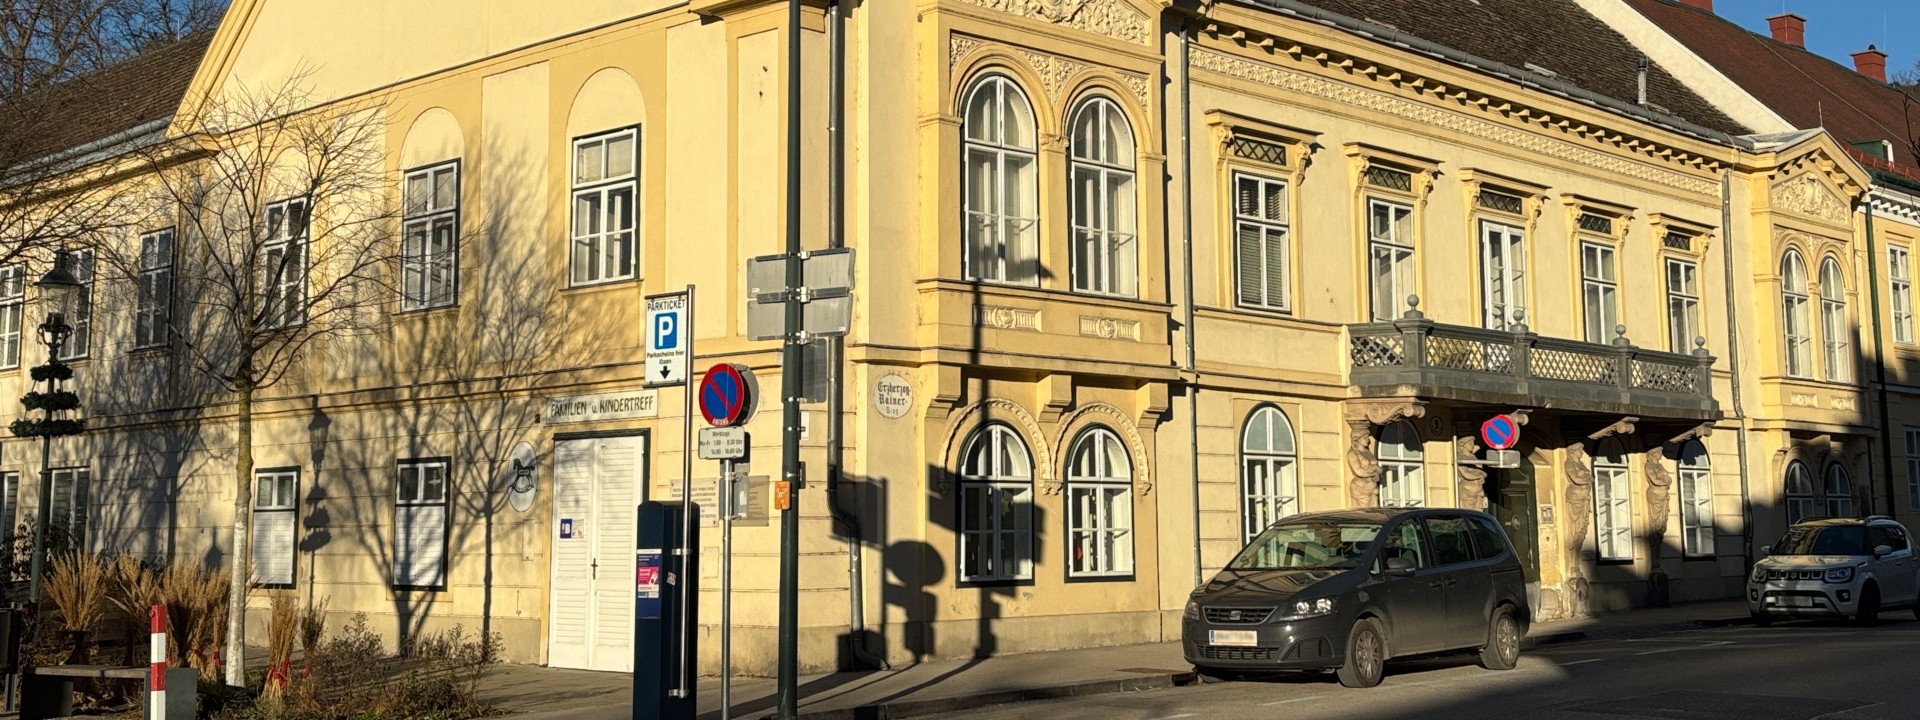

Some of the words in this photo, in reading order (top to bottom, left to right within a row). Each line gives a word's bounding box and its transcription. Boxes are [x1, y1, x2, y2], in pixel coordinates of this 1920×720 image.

[647, 299, 685, 312] PARKTICKET
[658, 315, 674, 347] P
[646, 351, 675, 359] Parkscheine
[879, 392, 908, 406] Rainer-
[550, 400, 587, 418] FAMILIEN
[599, 395, 654, 414] KINDERTREFF
